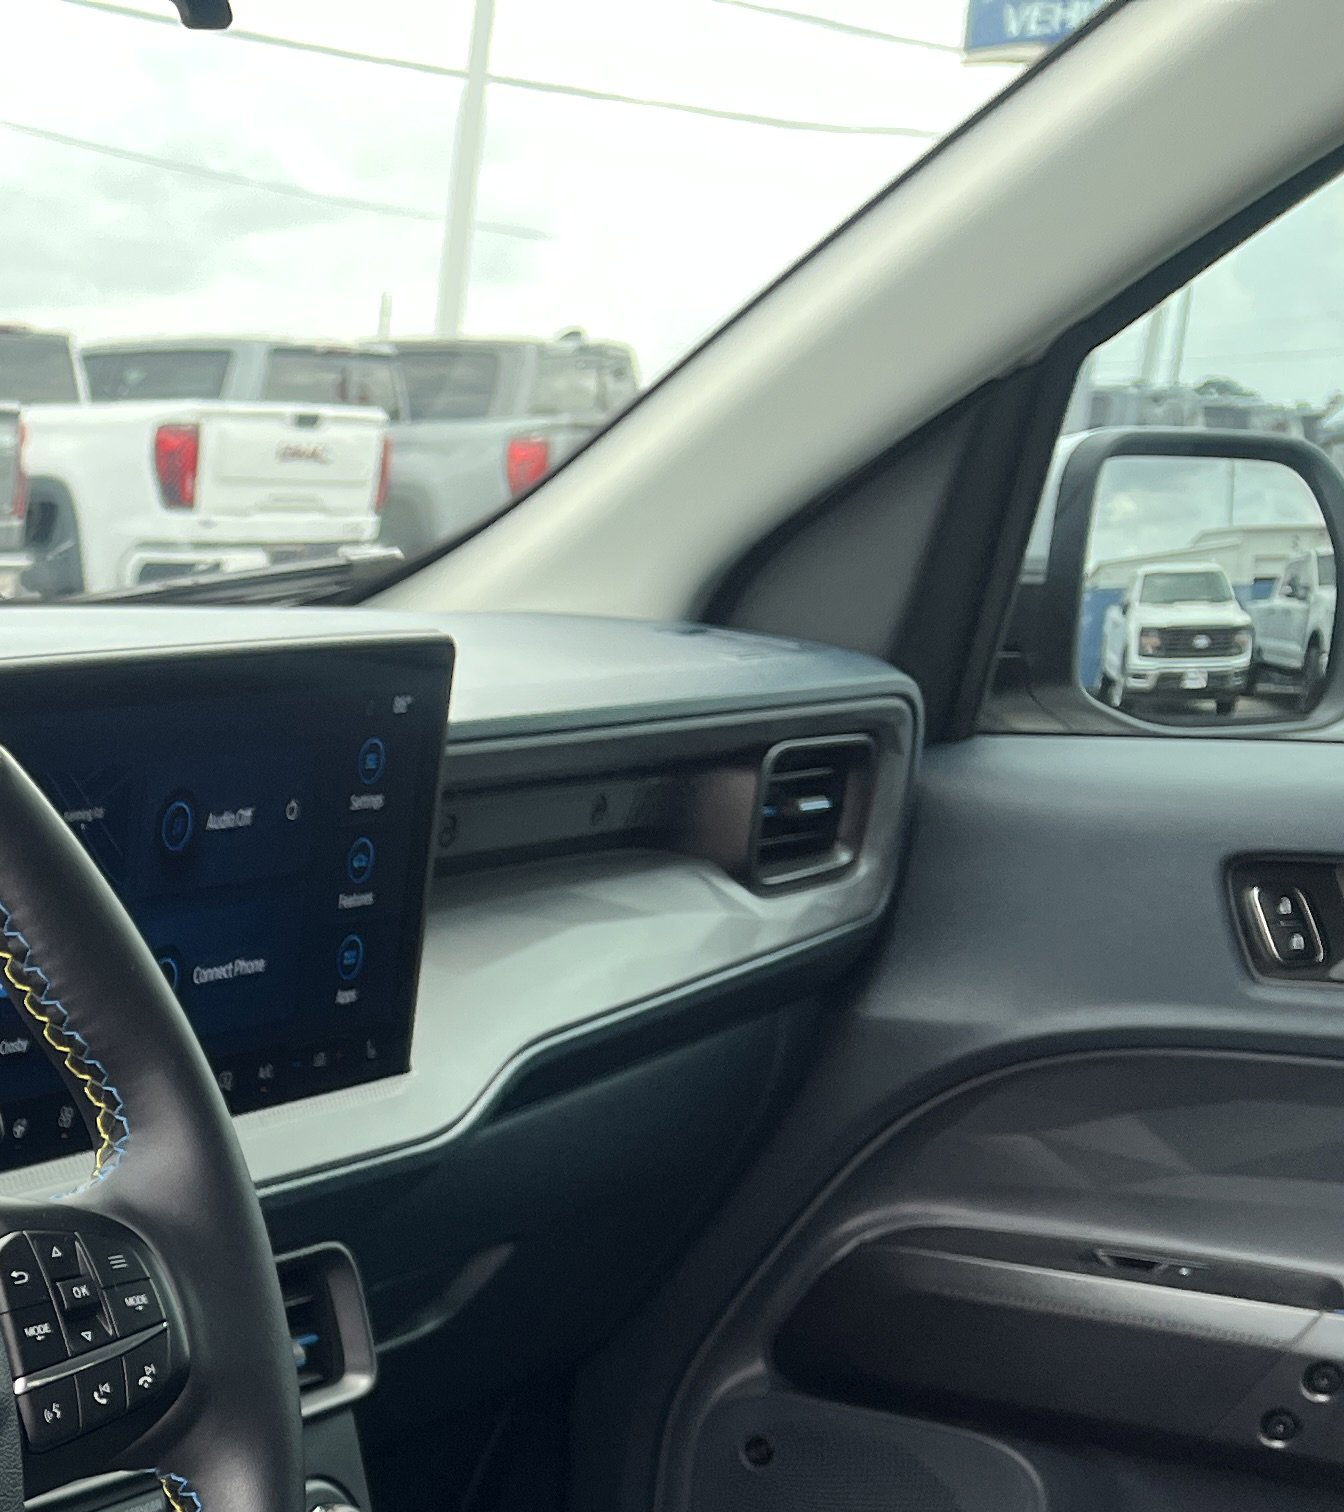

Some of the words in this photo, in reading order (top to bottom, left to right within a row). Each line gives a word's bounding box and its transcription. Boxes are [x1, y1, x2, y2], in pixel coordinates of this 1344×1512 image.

[192, 962, 233, 984] Connect
[233, 958, 266, 977] Phone
[72, 1284, 90, 1299] OK
[124, 1293, 149, 1307] MODE
[23, 1322, 51, 1337] MODE
